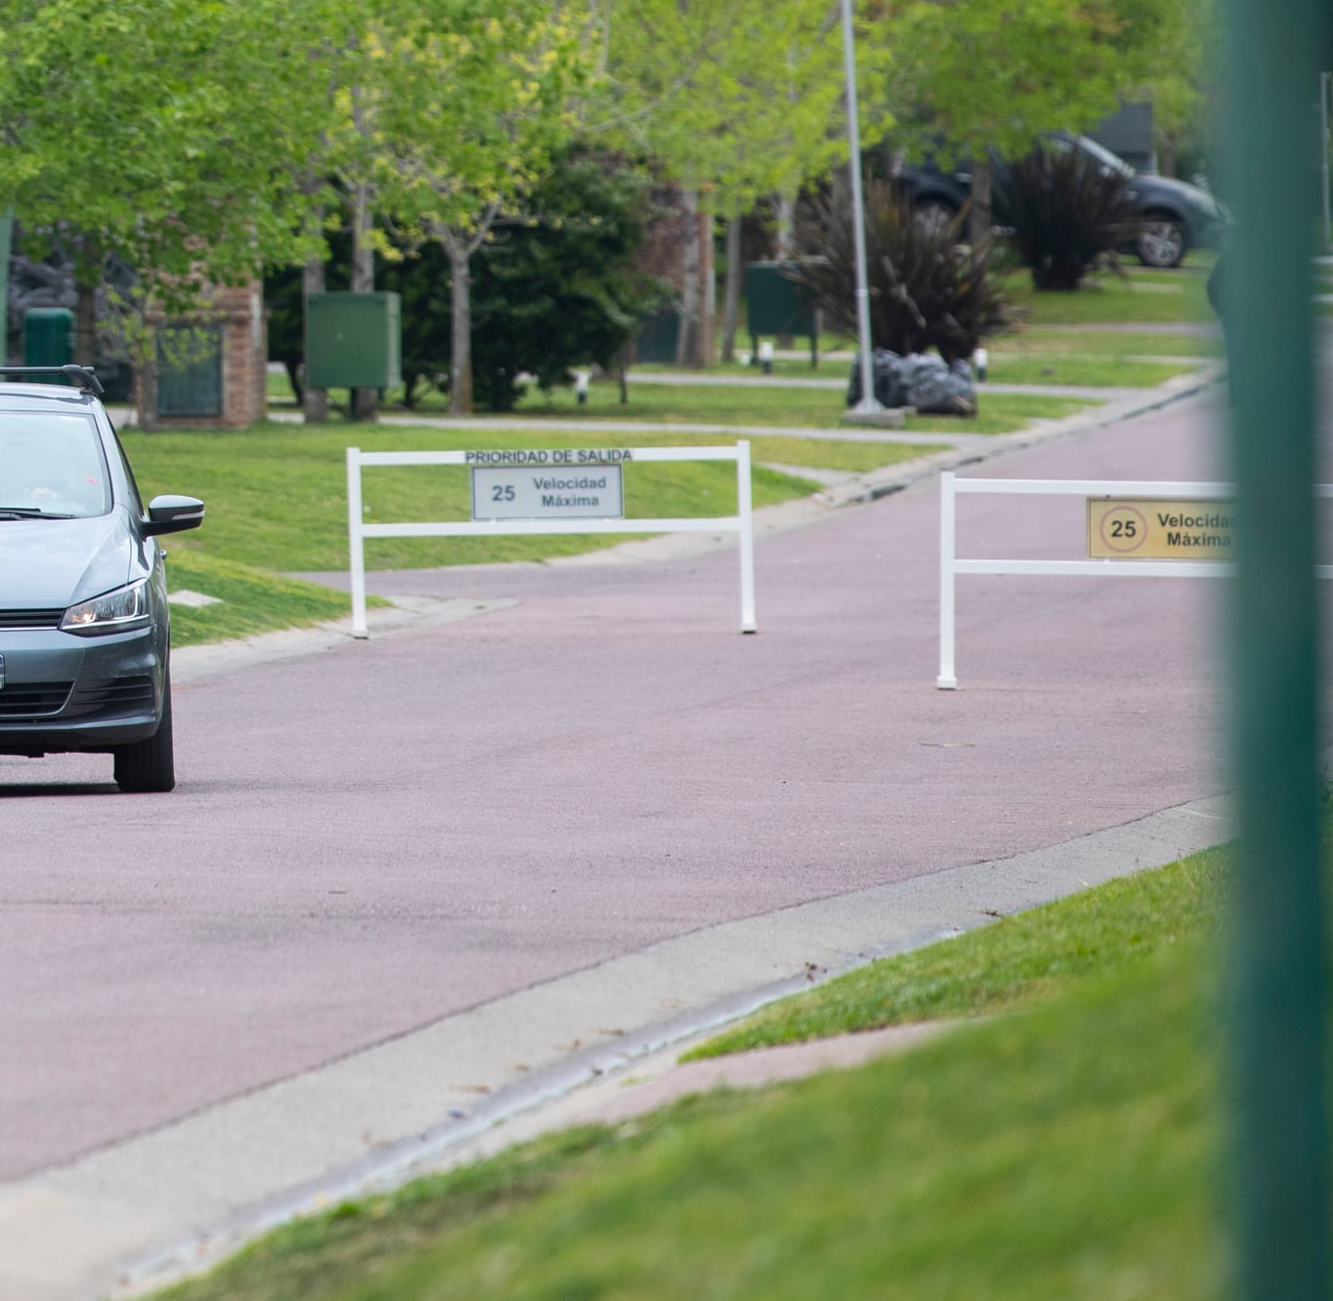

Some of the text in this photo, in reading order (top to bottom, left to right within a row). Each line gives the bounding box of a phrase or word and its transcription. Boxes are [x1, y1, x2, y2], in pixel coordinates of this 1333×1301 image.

[466, 449, 633, 463] PRIORIDAD DE SALIDA
[533, 477, 607, 490] Velocidad
[492, 485, 516, 501] 25
[542, 494, 599, 507] Máxima
[1111, 520, 1137, 538] 25
[1167, 530, 1231, 546] Máxima
